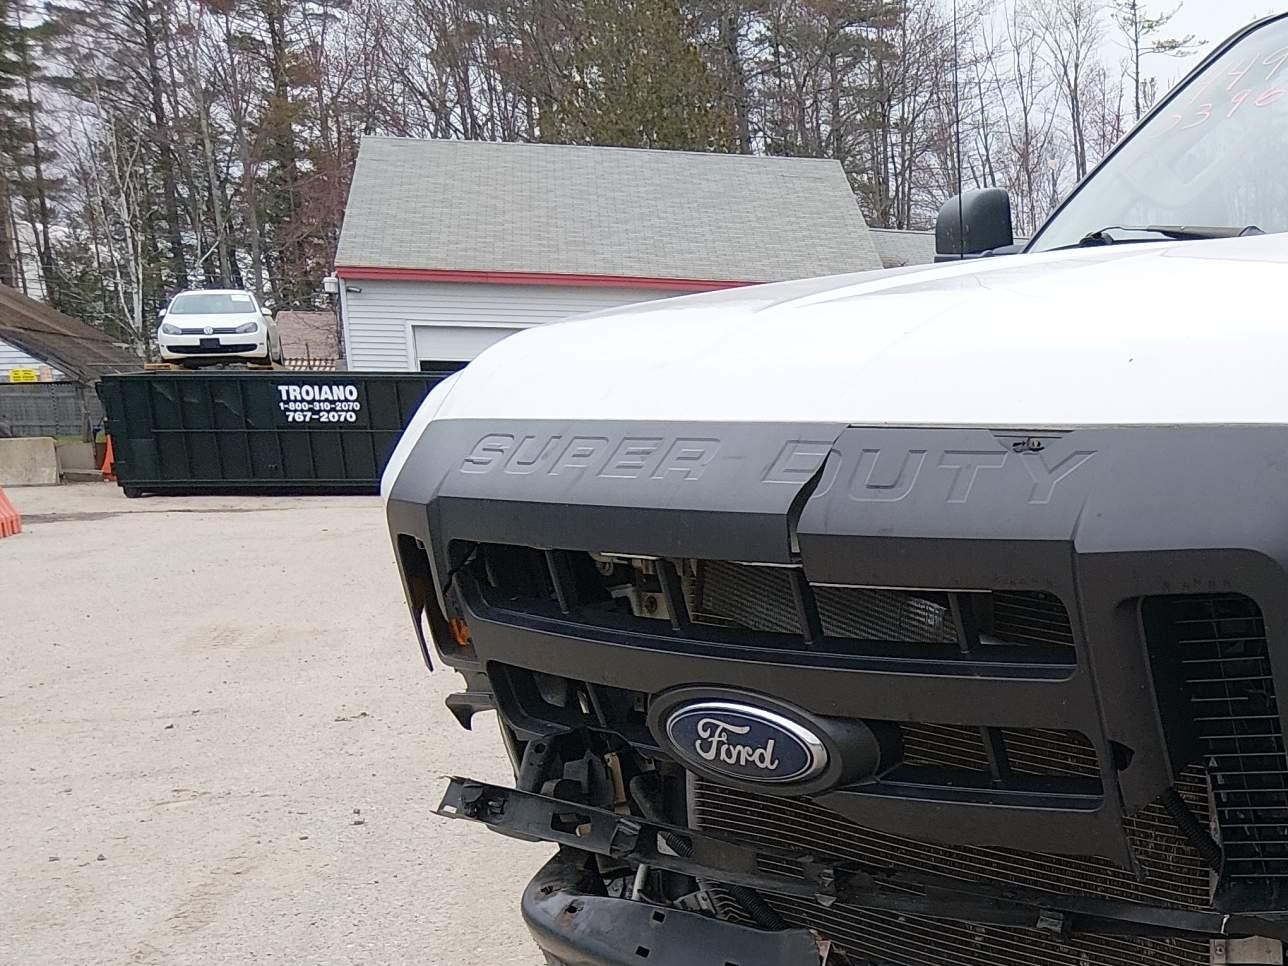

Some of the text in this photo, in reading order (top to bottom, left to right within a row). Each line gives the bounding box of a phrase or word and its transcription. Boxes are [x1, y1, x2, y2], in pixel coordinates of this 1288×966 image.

[277, 384, 359, 401] TROIANO
[278, 401, 361, 411] 1-800-310-2070
[285, 411, 357, 422] 767-2070
[460, 433, 1099, 505] SUPER DUTY
[695, 718, 779, 770] Ford
